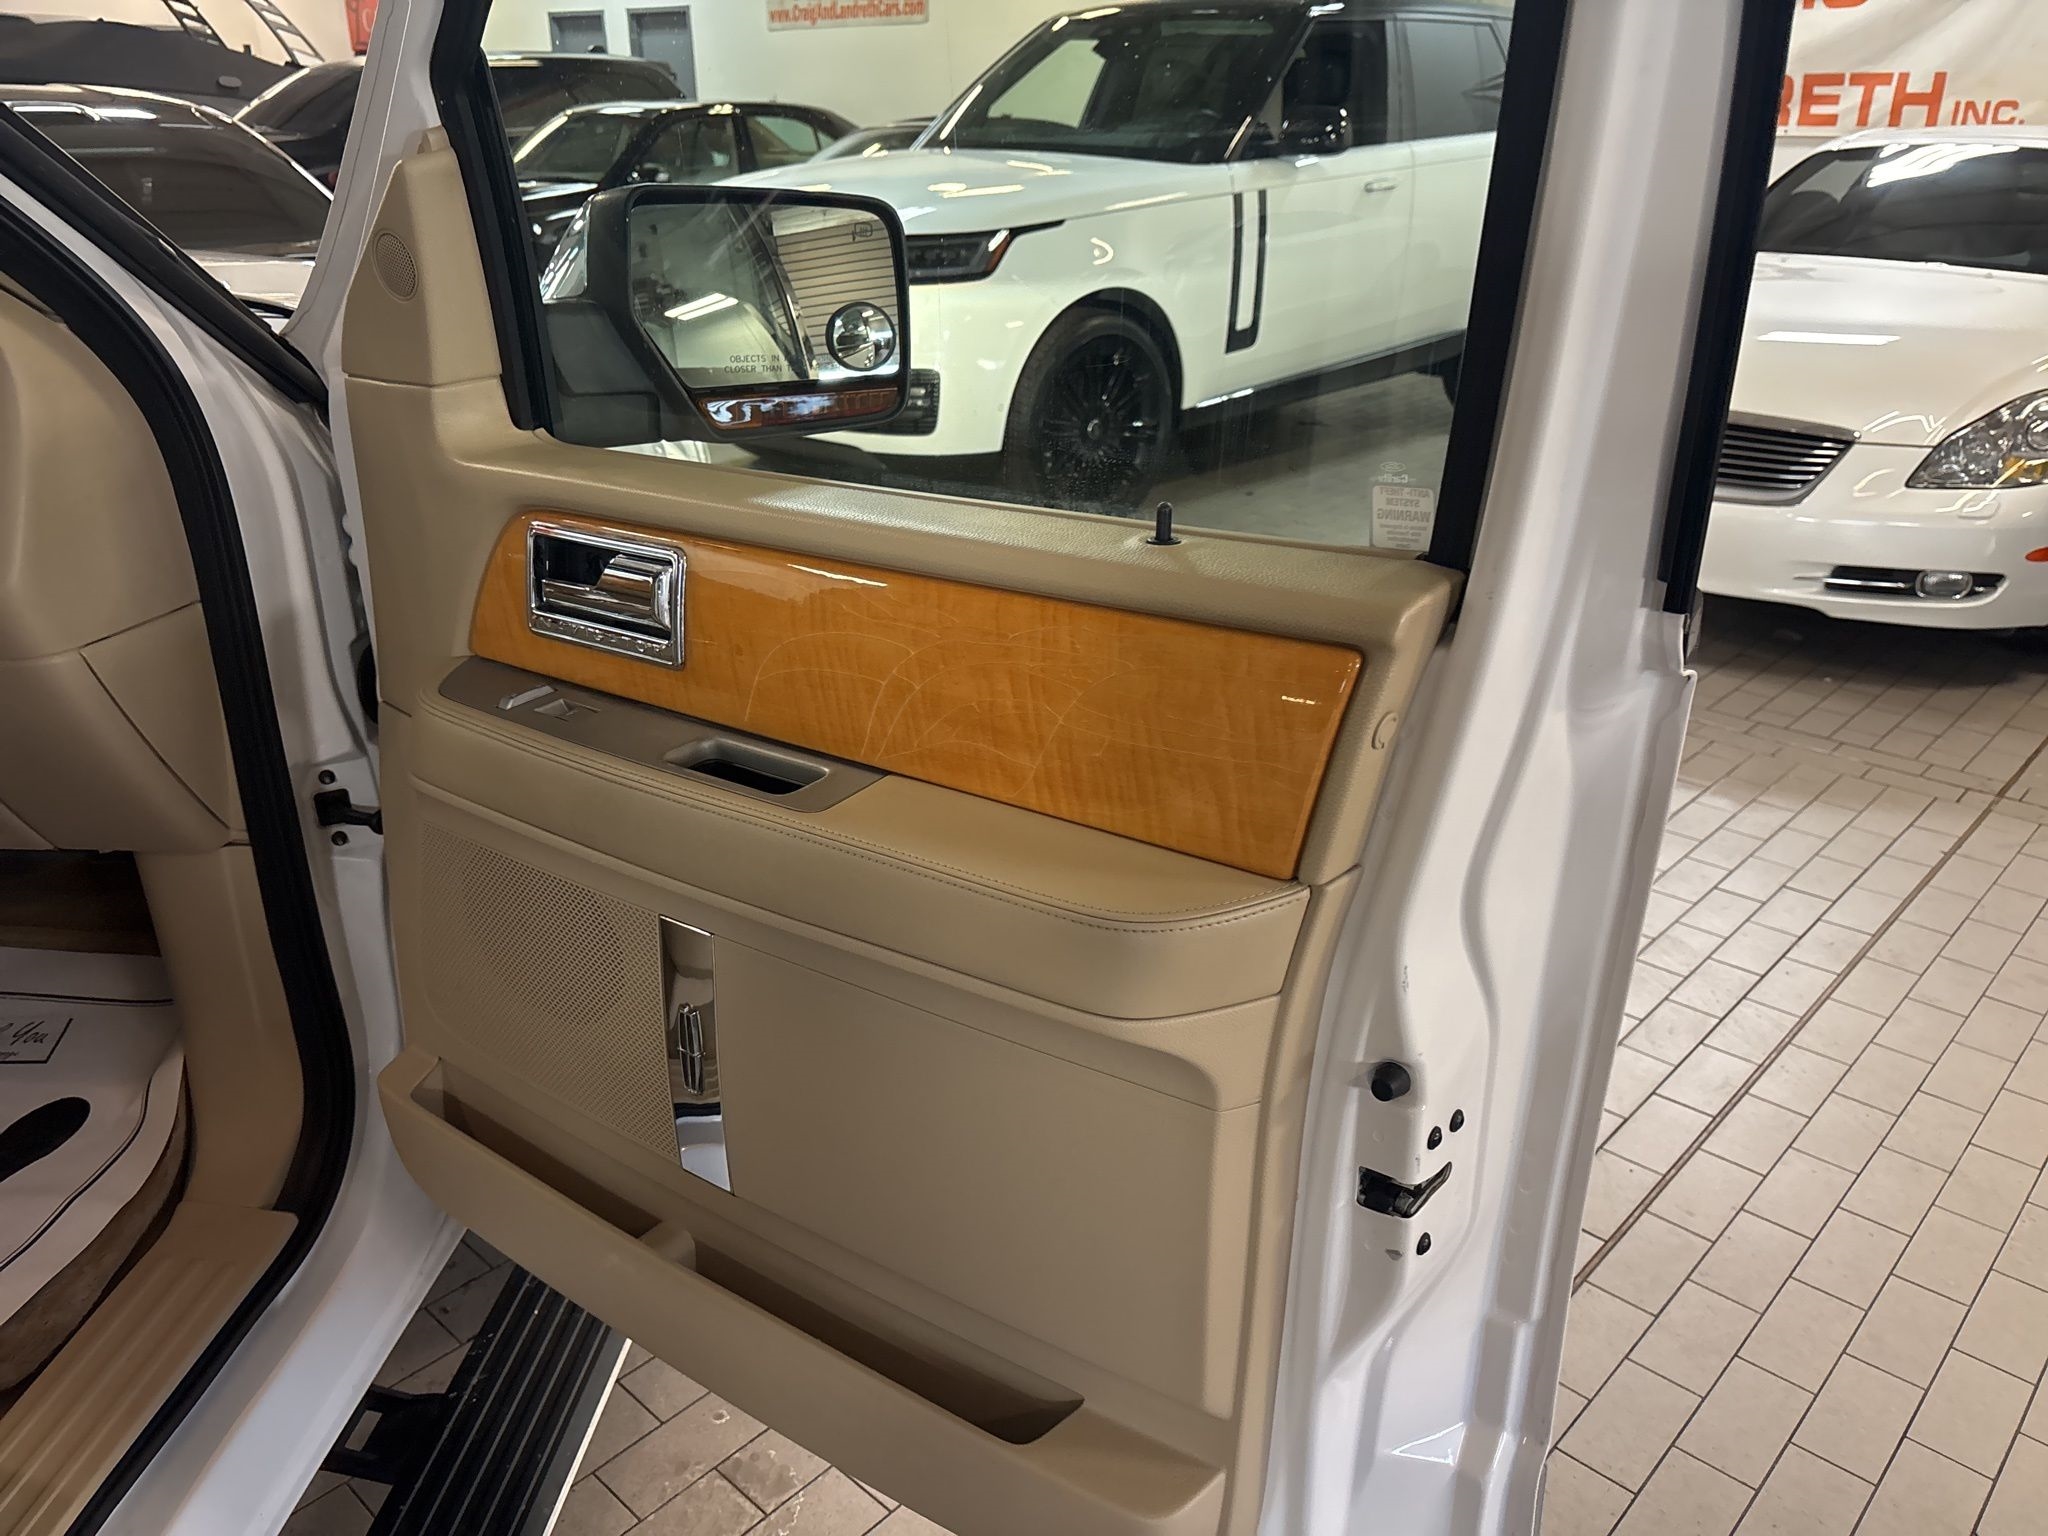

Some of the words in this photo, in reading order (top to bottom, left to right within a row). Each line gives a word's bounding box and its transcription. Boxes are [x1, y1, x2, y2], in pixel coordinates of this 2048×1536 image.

[1951, 100, 2026, 126] INC.
[729, 354, 767, 364] OBJECTS
[771, 354, 780, 363] IN
[724, 365, 756, 374] CLOSER
[762, 364, 782, 373] THAN
